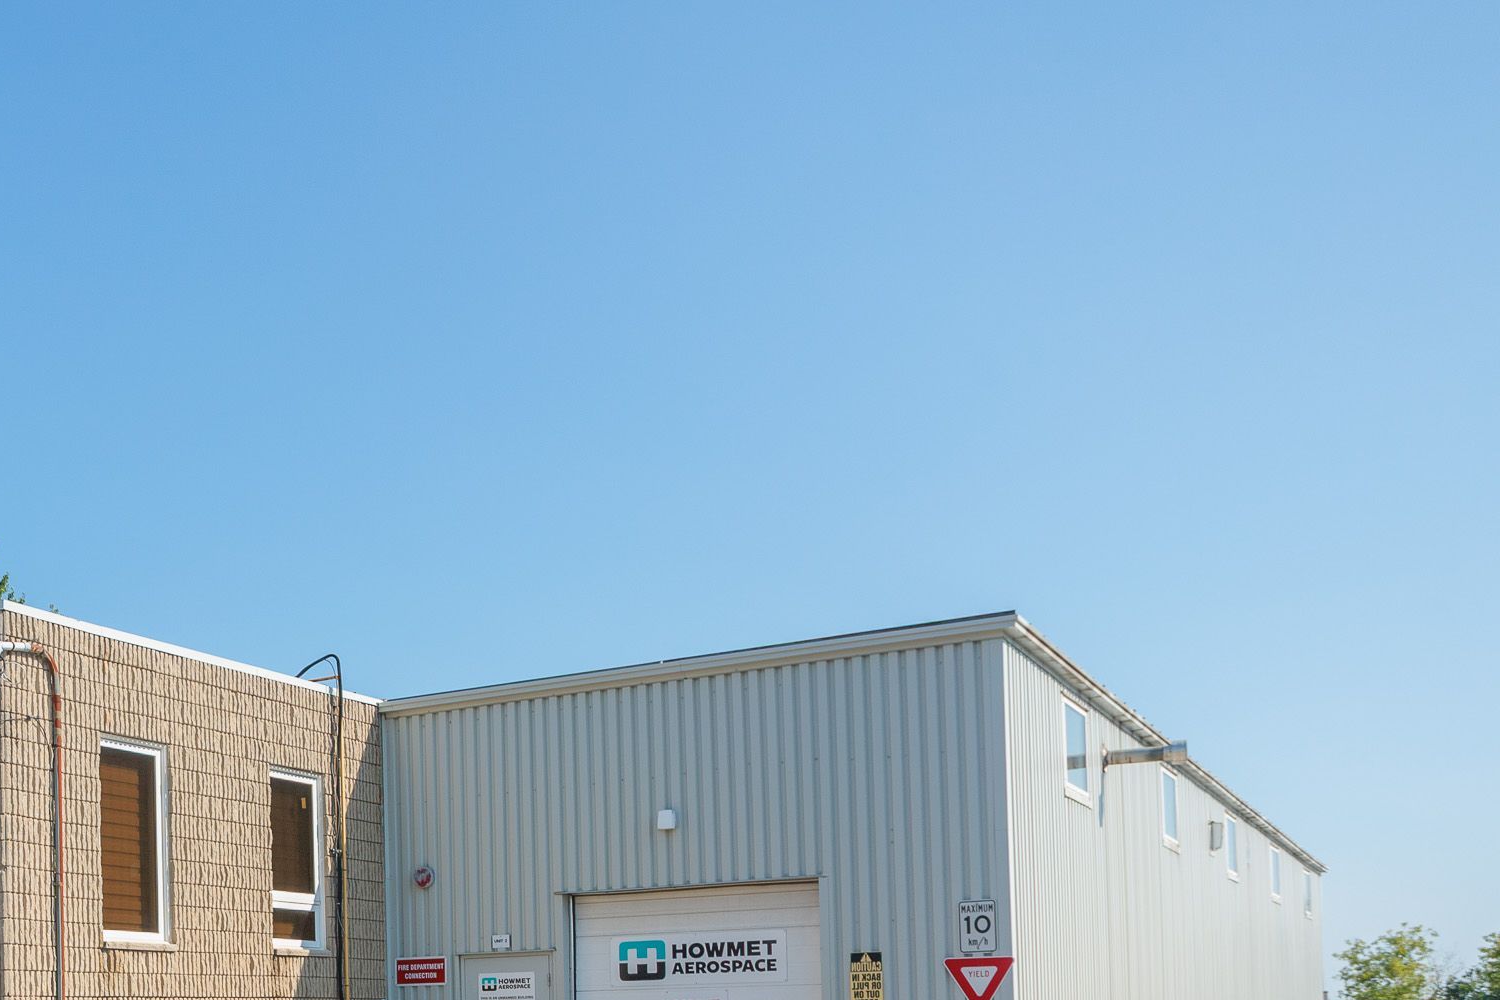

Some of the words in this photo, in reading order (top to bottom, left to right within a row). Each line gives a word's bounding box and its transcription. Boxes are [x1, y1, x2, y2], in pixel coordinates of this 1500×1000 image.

[961, 903, 994, 914] MAXIMUM
[964, 915, 991, 934] 10
[968, 937, 988, 947] km/h
[671, 939, 777, 959] HOWMET
[410, 963, 444, 971] DEPARTMENT
[671, 958, 777, 975] AEROSPACE
[968, 970, 990, 978] YIELD
[498, 977, 531, 985] HOWMET
